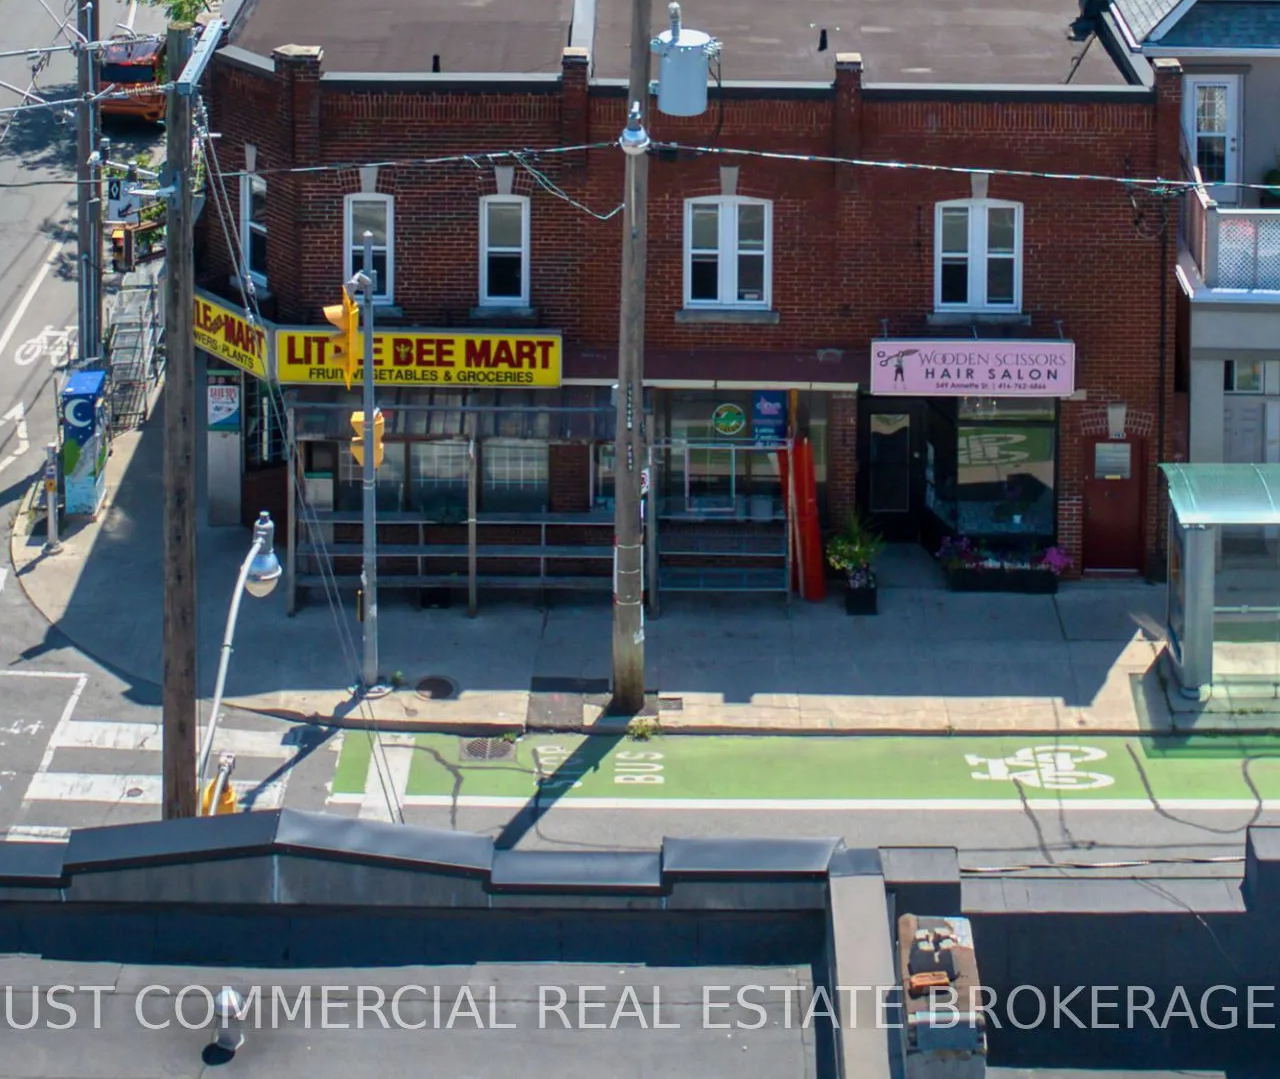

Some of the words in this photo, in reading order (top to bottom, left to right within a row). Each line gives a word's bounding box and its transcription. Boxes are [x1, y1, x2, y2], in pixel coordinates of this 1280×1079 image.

[223, 313, 266, 359] MART
[222, 344, 255, 370] PLANTS
[286, 335, 385, 366] LITE
[392, 337, 456, 368] BEE
[464, 338, 555, 370] MART
[918, 349, 990, 367] WOODEN
[994, 352, 1067, 367] SCISSORS
[308, 367, 345, 380] FRUI
[443, 370, 452, 382] &
[456, 370, 534, 383] GROCERIES
[925, 367, 975, 380] HAIR
[987, 368, 1058, 381] SALON
[613, 750, 666, 785] BUS
